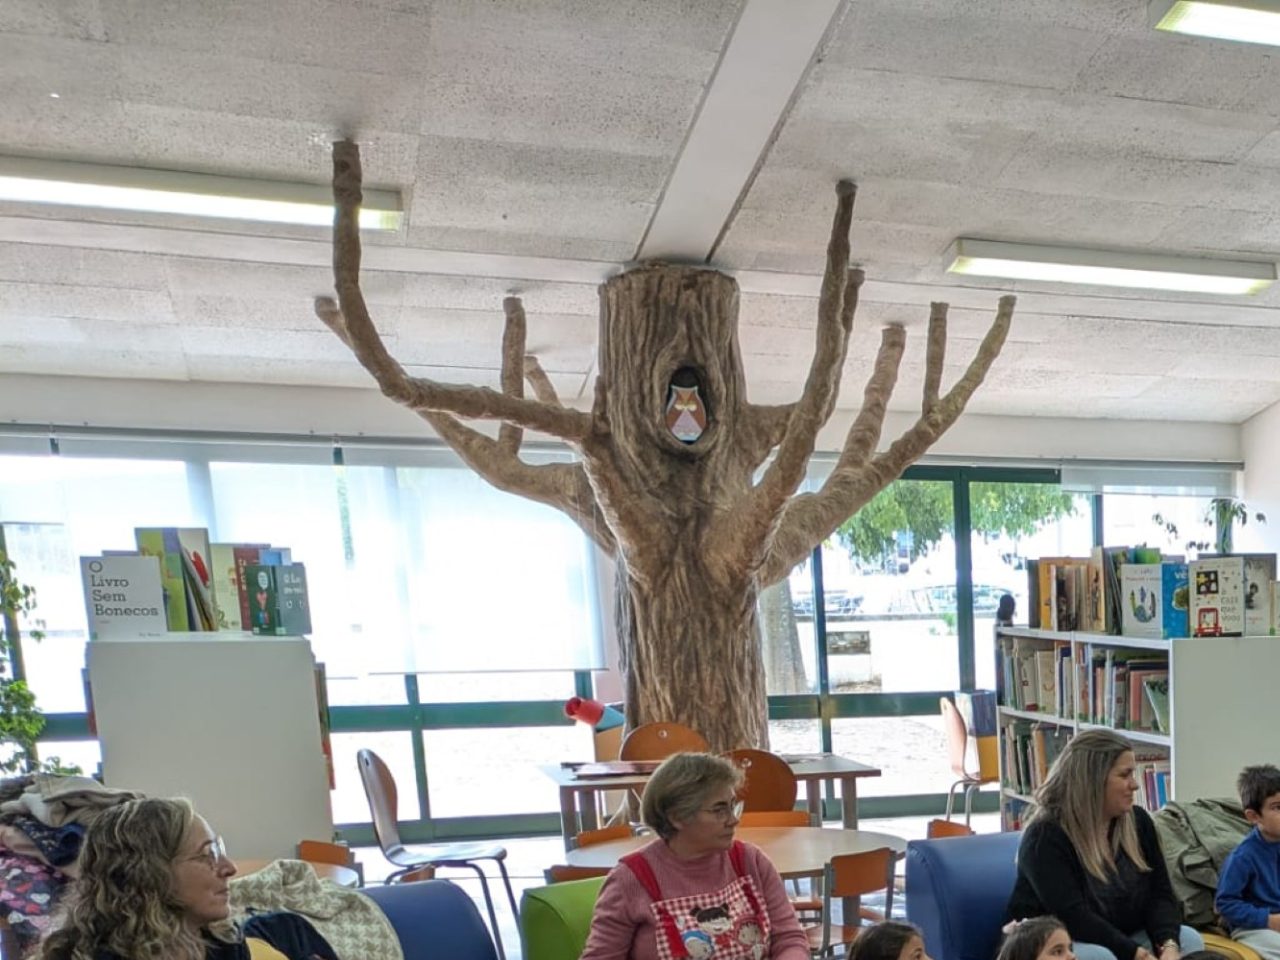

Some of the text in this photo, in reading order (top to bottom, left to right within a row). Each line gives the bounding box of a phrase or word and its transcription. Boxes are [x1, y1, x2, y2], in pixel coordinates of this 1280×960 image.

[89, 561, 103, 573] O
[91, 574, 129, 587] Livro
[92, 589, 127, 602] Sem
[95, 603, 159, 617] Bonecos
